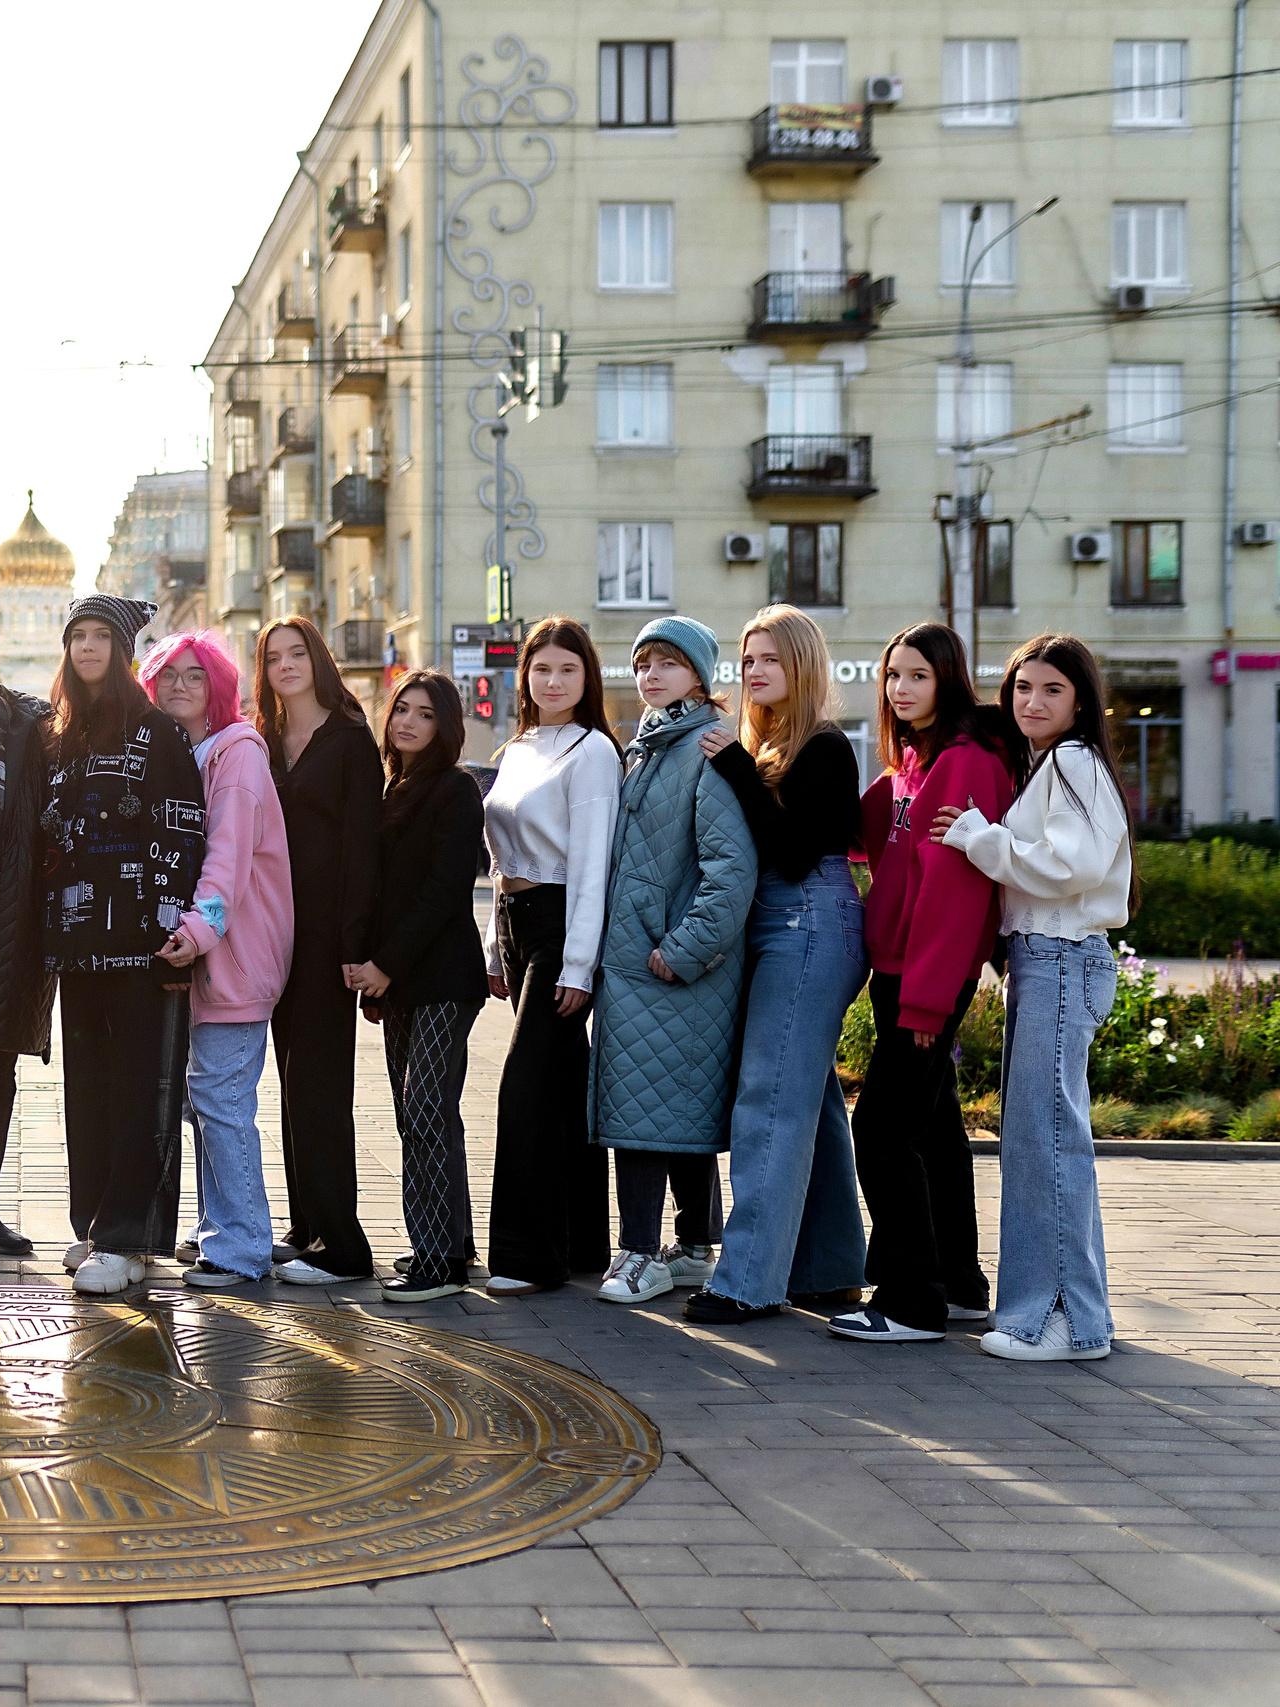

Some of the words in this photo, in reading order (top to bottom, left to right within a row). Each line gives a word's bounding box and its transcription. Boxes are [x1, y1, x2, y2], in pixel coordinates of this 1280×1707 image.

[475, 701, 493, 718] 40
[154, 874, 168, 886] 59
[493, 1477, 577, 1517] ПАРИЖ
[355, 1518, 499, 1557] ЛОНДОН
[76, 1549, 346, 1580] ВАШИНГТОН
